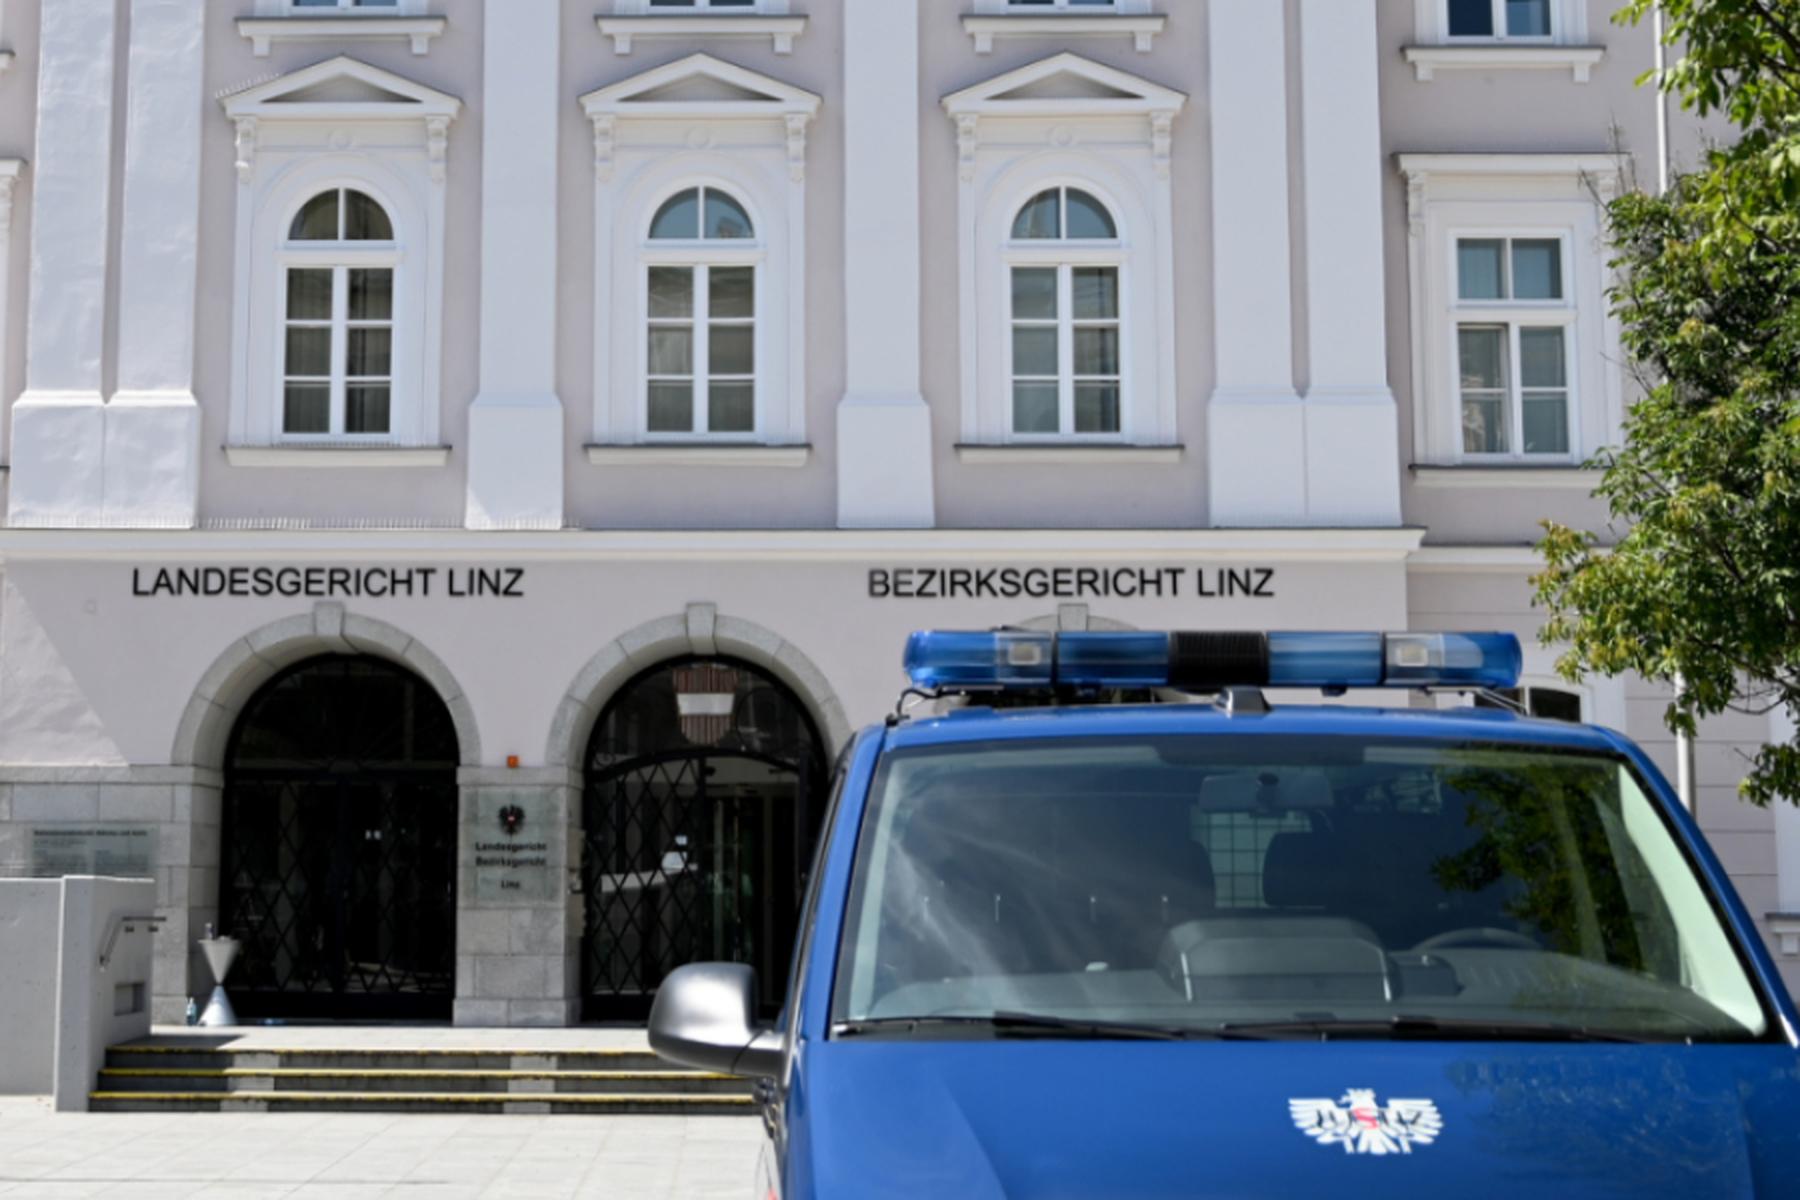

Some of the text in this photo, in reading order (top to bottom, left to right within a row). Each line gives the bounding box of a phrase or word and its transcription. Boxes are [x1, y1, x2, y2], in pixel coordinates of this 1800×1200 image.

[132, 566, 525, 598] LANDESGERICHT LINZ
[868, 567, 1275, 598] BEZIRKSGERICHT LINZ
